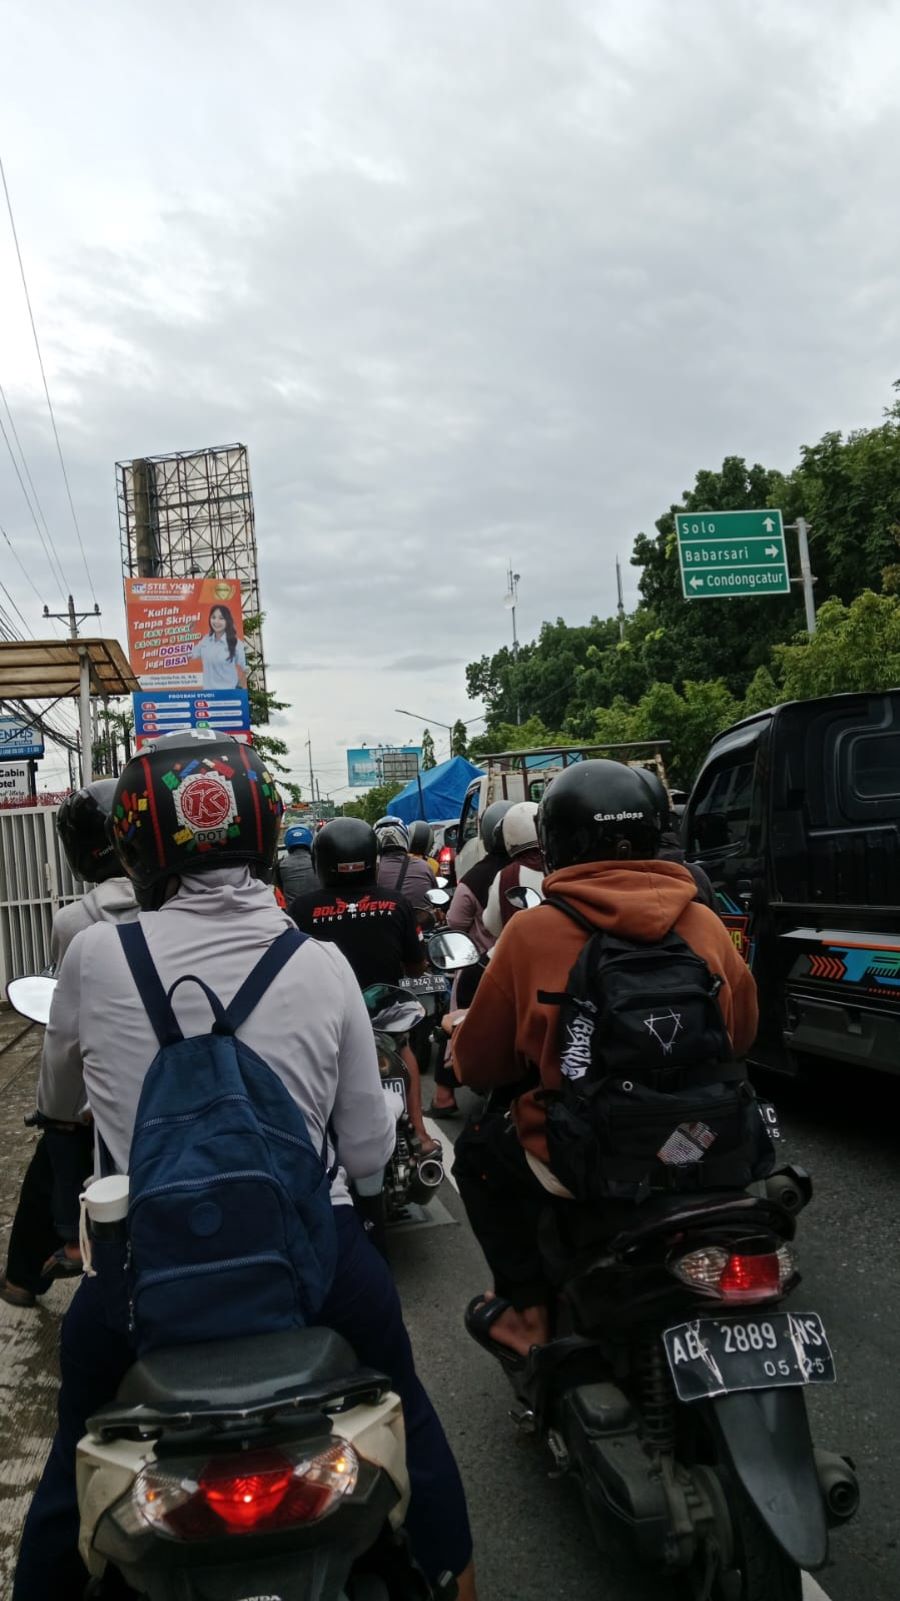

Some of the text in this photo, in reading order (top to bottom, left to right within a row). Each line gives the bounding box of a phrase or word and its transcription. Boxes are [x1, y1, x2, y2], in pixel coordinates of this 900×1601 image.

[682, 521, 716, 534] Solo
[685, 546, 749, 562] Babarsari
[707, 572, 783, 588] Condongcatur
[160, 644, 193, 656] DOSEN
[197, 831, 223, 842] DOT
[721, 1322, 777, 1353] 2889
